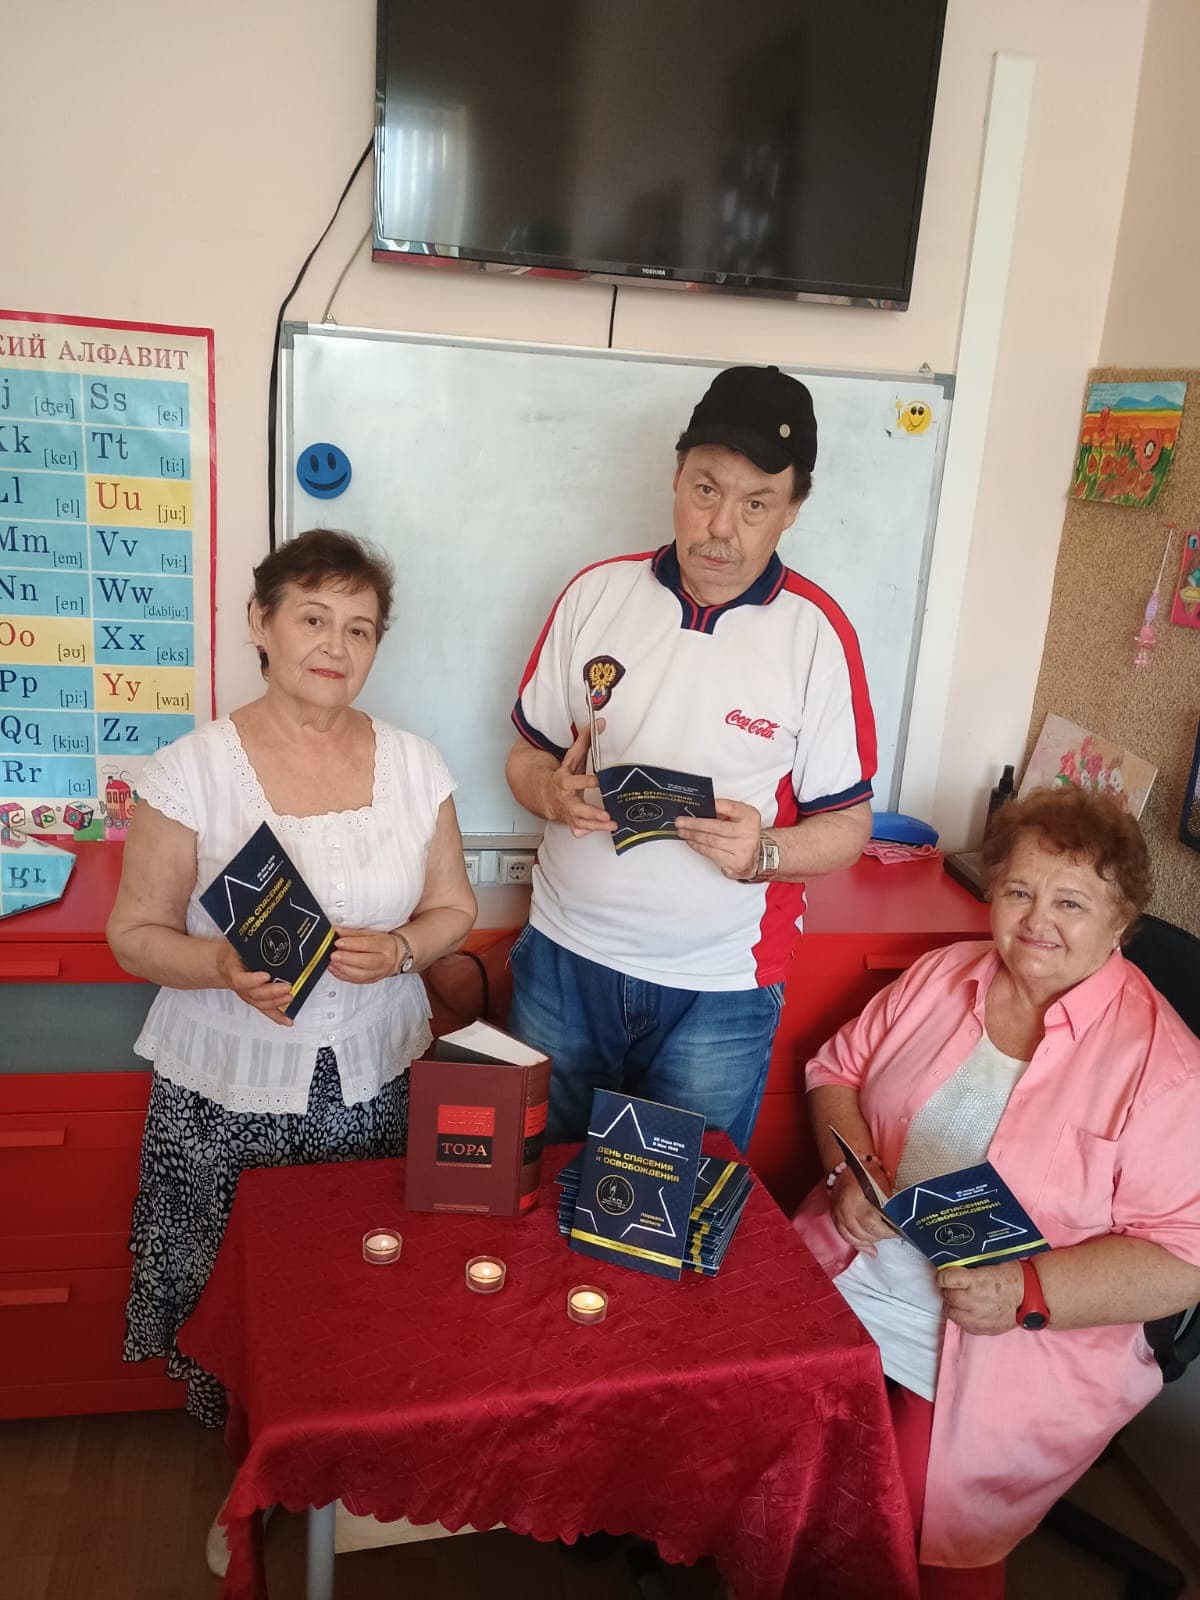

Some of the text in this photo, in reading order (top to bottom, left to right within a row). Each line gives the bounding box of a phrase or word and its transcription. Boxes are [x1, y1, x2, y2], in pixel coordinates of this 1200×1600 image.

[641, 267, 666, 276] TOSHIBA
[58, 340, 189, 370] АЛФАВИТ
[90, 382, 127, 412] Ss
[92, 431, 128, 460] Tt
[94, 481, 142, 511] Uu
[96, 530, 139, 557] Vv
[96, 577, 154, 604] Ww
[101, 625, 147, 651] Xx
[102, 672, 142, 702] Yy
[0, 715, 42, 745] Qq
[103, 717, 139, 742] Zz
[2, 759, 42, 783] Rr
[441, 1142, 488, 1157] ТОРА
[597, 1146, 674, 1172] ДЕНЬ СПАСЕНИЯ
